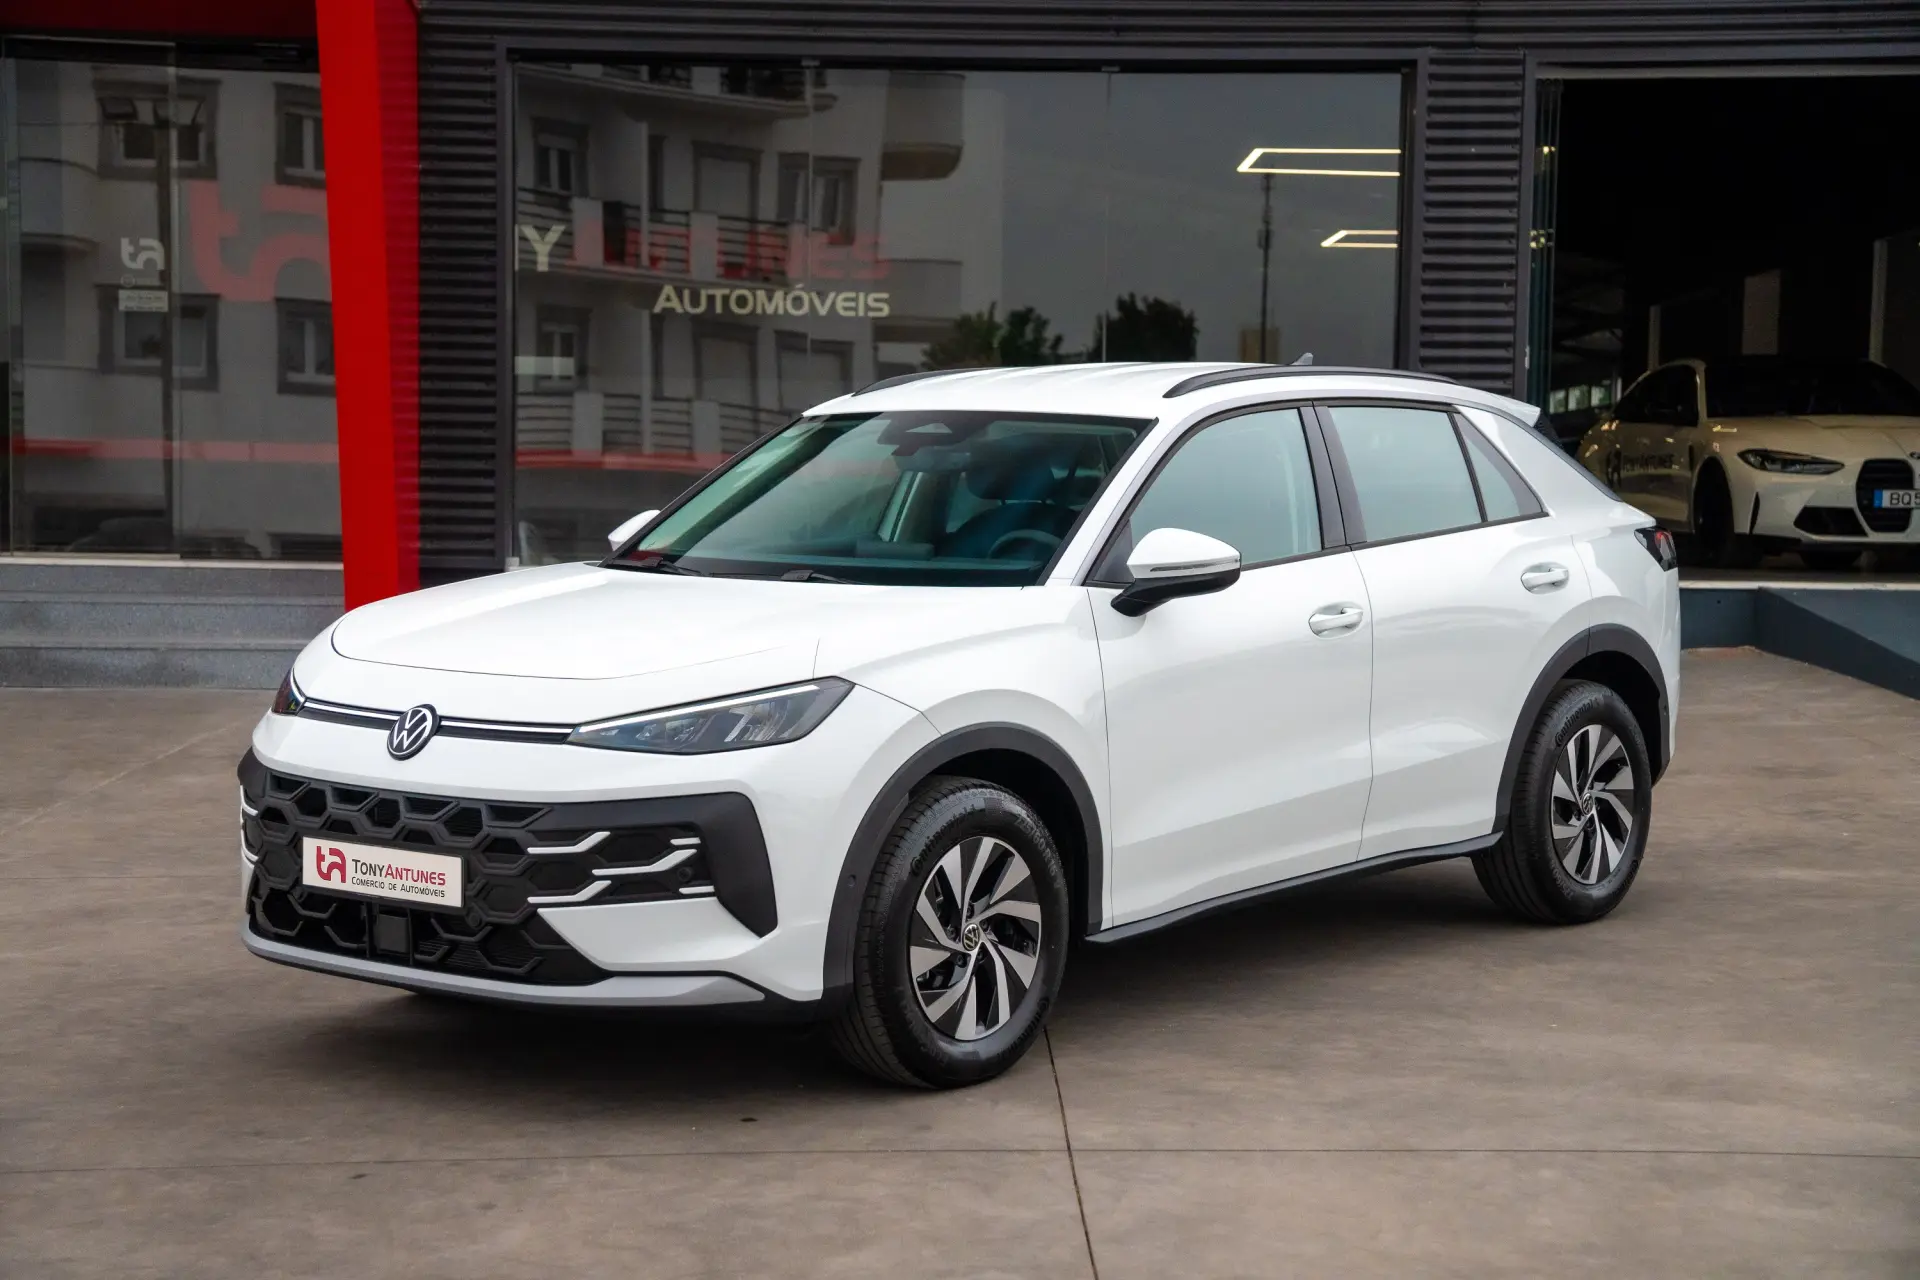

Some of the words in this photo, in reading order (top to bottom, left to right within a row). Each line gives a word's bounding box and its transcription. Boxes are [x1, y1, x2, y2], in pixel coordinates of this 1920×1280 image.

[653, 284, 890, 319] AUTOMÓVEIS
[1890, 491, 1912, 506] BQ
[351, 858, 446, 886] TONYANTUNES
[388, 882, 397, 891] DE
